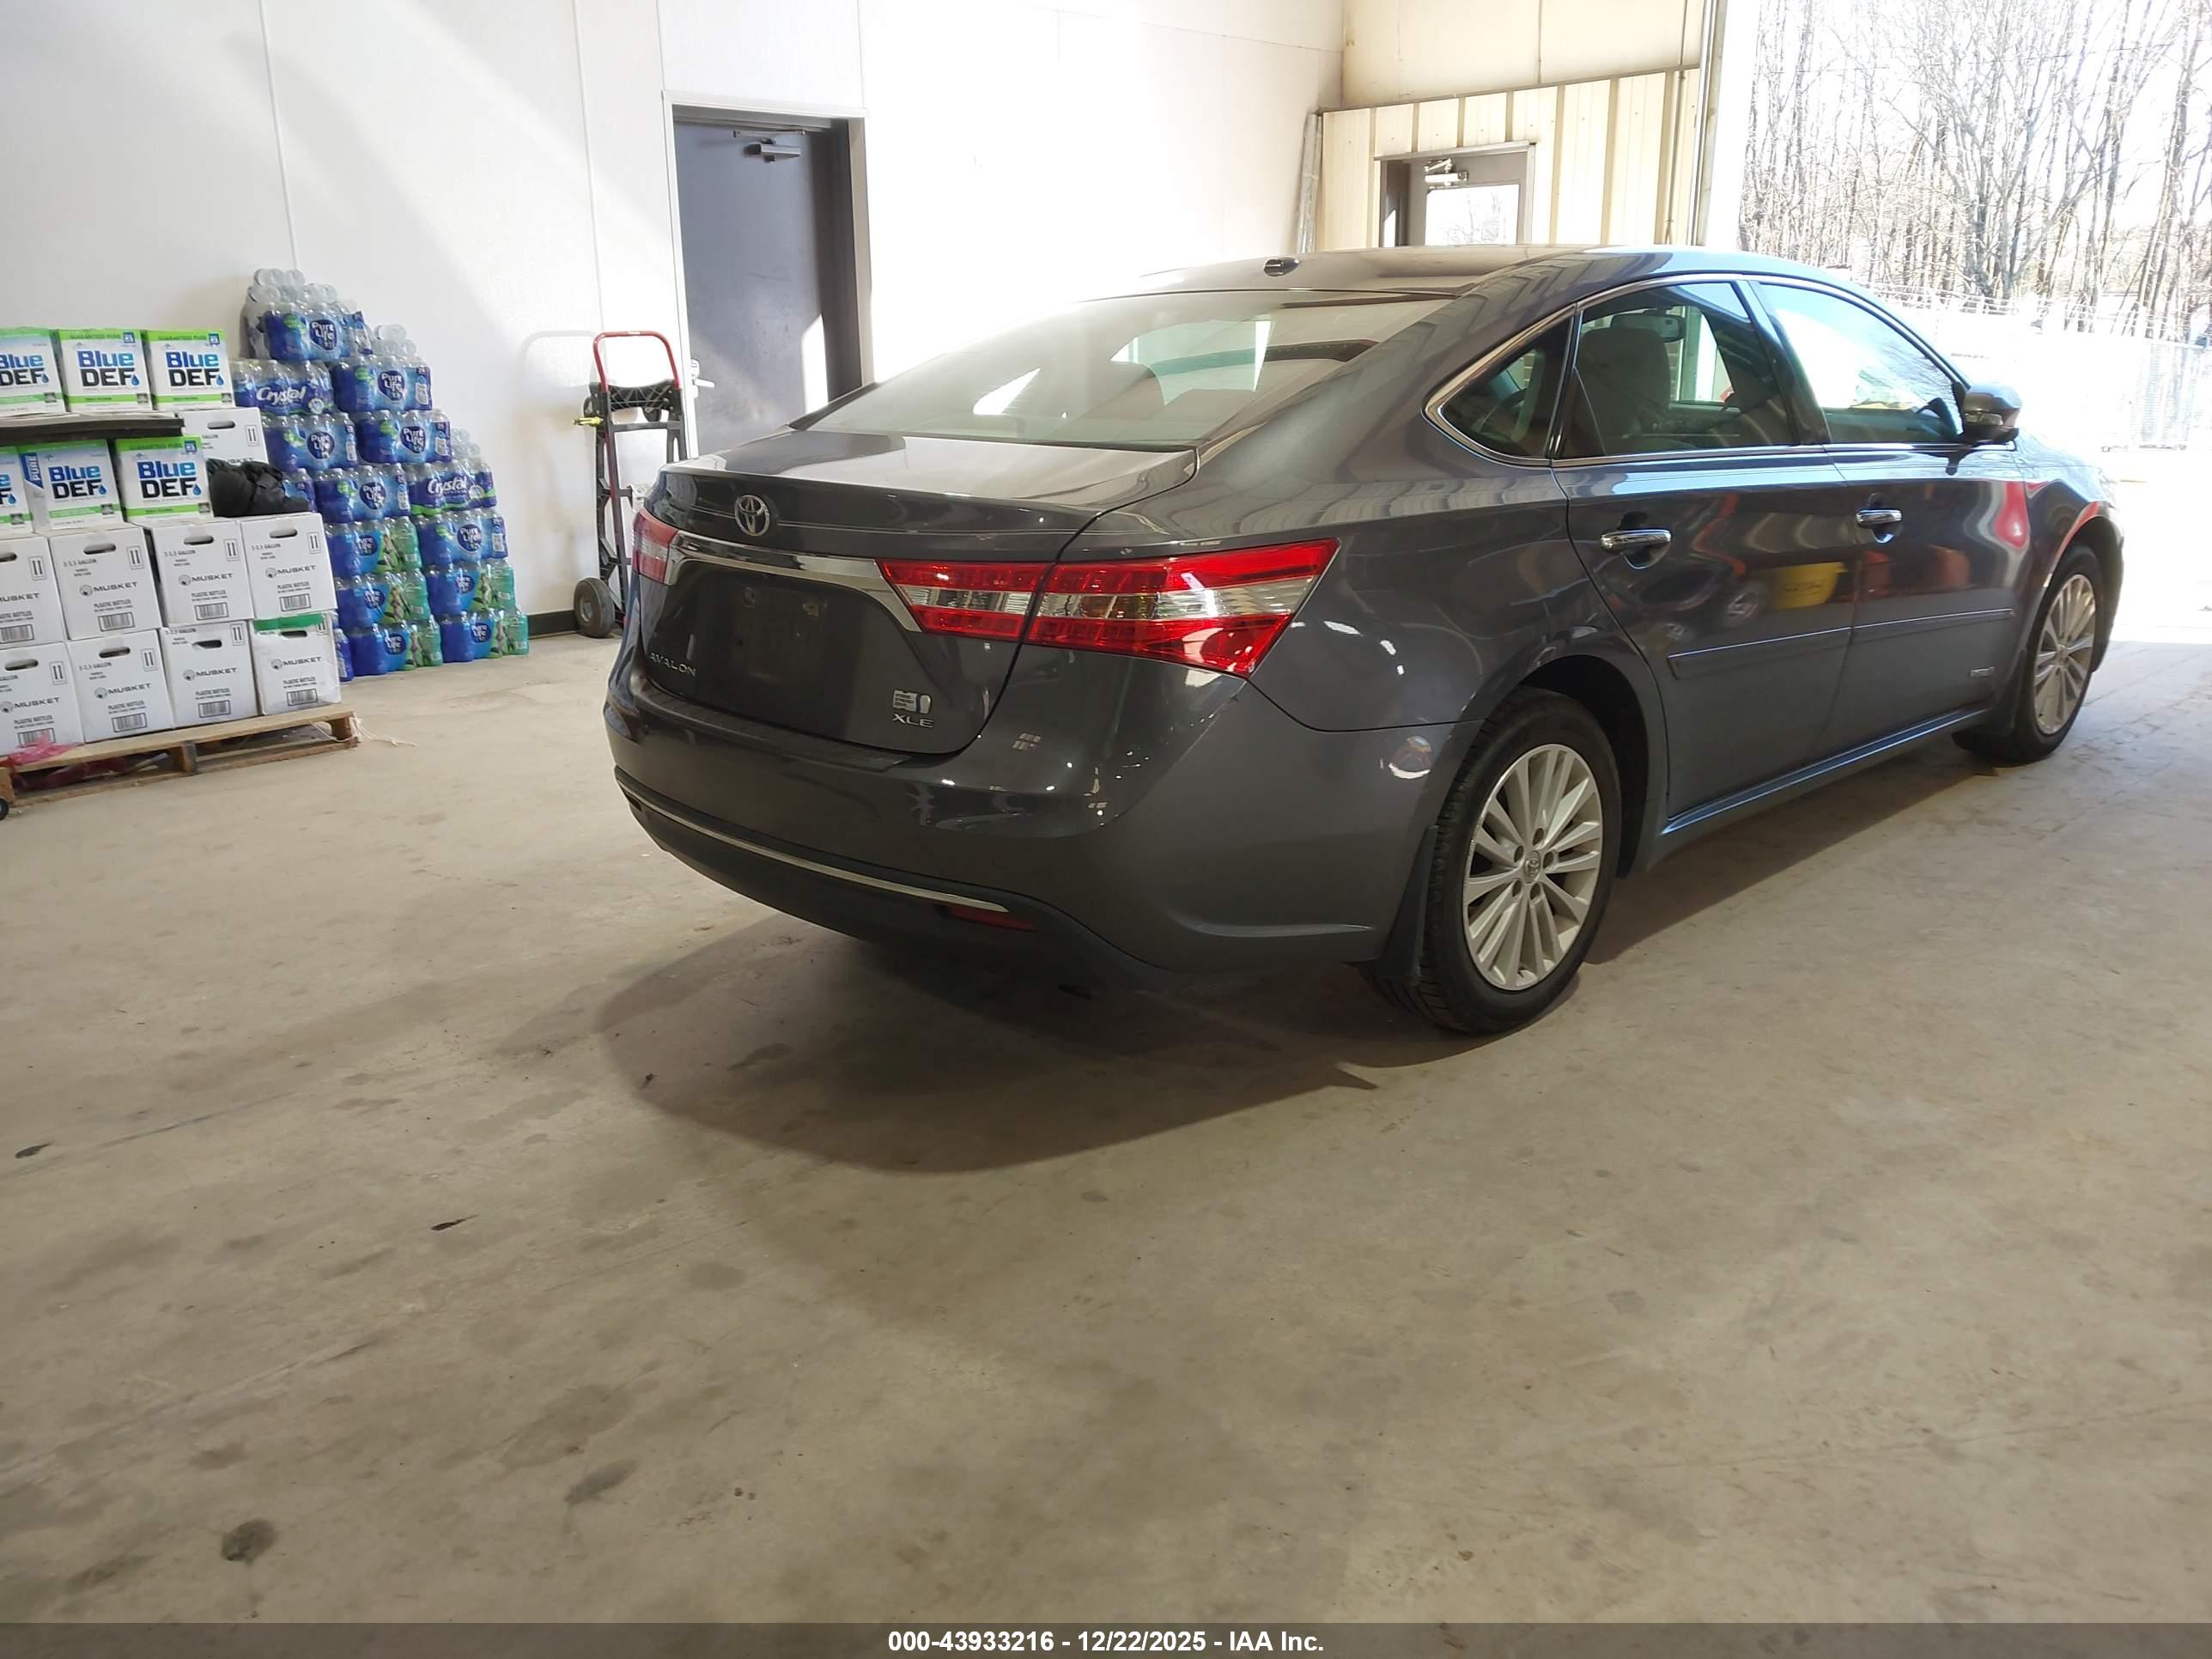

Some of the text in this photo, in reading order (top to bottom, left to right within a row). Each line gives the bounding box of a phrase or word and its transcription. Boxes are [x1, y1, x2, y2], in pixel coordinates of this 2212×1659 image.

[0, 354, 43, 368] Blue
[78, 350, 134, 367] Blue
[166, 351, 219, 368] Blue
[0, 368, 45, 386] DEF
[81, 368, 135, 386] DEF
[168, 368, 220, 386] DEF
[256, 386, 307, 406] Crystal
[48, 465, 101, 482] Blue
[137, 460, 196, 478] Blue
[52, 479, 102, 499] DEF
[140, 477, 197, 498] DEF
[428, 476, 467, 497] Crystal
[192, 573, 233, 582] MUSKET
[277, 564, 316, 574] MUSKET
[94, 581, 137, 592] MUSKET
[283, 656, 321, 666] MUSKET
[650, 652, 696, 678] AVALON
[196, 666, 237, 677] MUSKET
[108, 683, 151, 694] MUSKET
[14, 696, 60, 708] MUSKET
[892, 713, 934, 729] XLE
